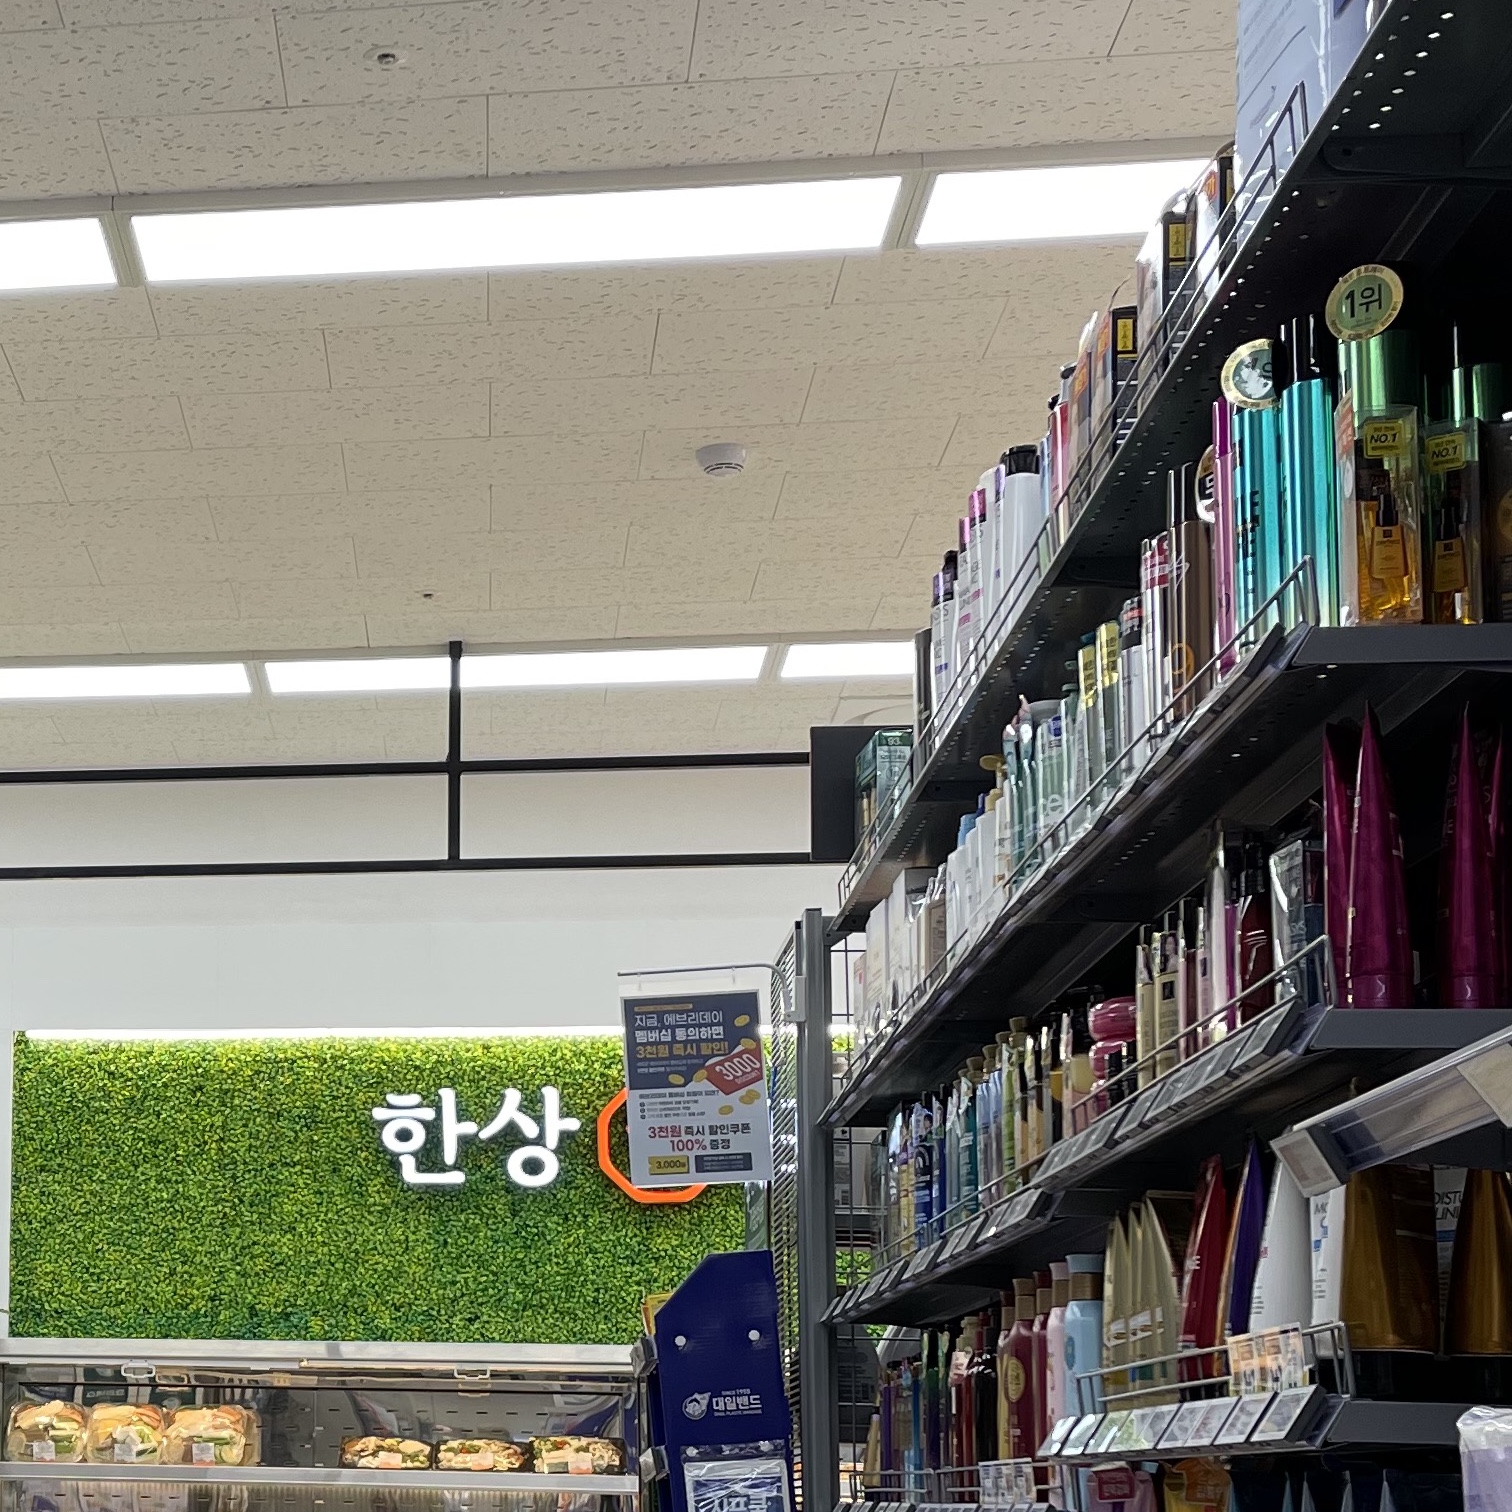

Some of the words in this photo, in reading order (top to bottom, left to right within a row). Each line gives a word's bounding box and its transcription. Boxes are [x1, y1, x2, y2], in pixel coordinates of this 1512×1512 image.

[1345, 283, 1382, 320] 1위
[1369, 430, 1399, 446] NO.1
[634, 1013, 662, 1027] 지금,
[663, 1010, 723, 1026] 에브리데이
[634, 1028, 672, 1043] 멤버십
[675, 1025, 724, 1041] 동의하면
[635, 1044, 670, 1059] 3천원
[673, 1042, 697, 1057] 즉시
[700, 1041, 729, 1055] 할인!
[714, 1053, 761, 1081] 3000
[372, 1085, 582, 1188] 한상
[647, 1125, 682, 1139] 3천원
[684, 1124, 705, 1137] 즉시
[708, 1122, 752, 1135] 할인쿠폰
[669, 1138, 708, 1153] 100%
[709, 1138, 731, 1150] 증정
[712, 1395, 763, 1413] 대일밴드
